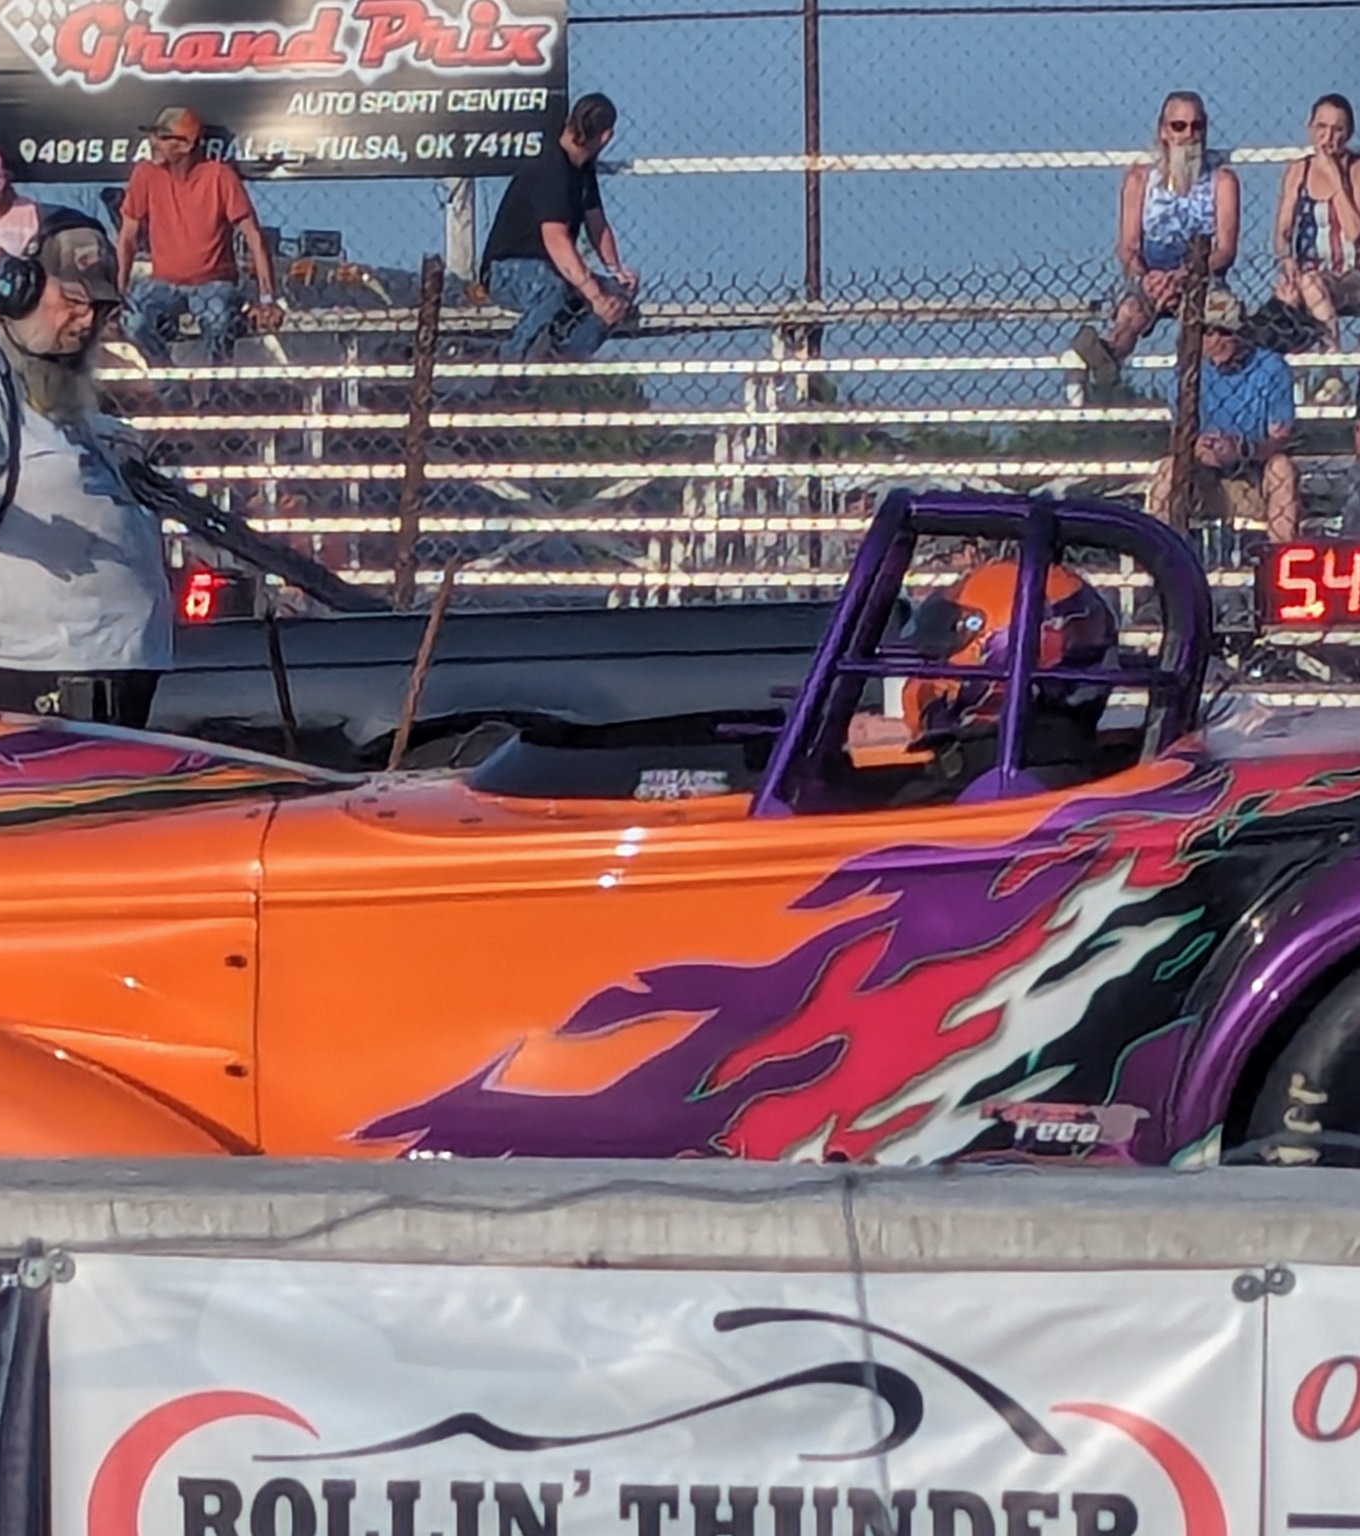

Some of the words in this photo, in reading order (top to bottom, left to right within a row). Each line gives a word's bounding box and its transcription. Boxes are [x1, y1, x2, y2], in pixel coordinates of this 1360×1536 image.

[54, 3, 344, 83] Grand
[355, 0, 550, 68] Prix
[287, 91, 357, 117] AUTO
[360, 90, 440, 115] SPORT
[448, 88, 548, 113] CENTER
[109, 139, 130, 163] E
[133, 138, 258, 163] ARAL
[314, 134, 408, 162] TULSA,
[415, 133, 455, 158] OK
[463, 131, 542, 158] 74115
